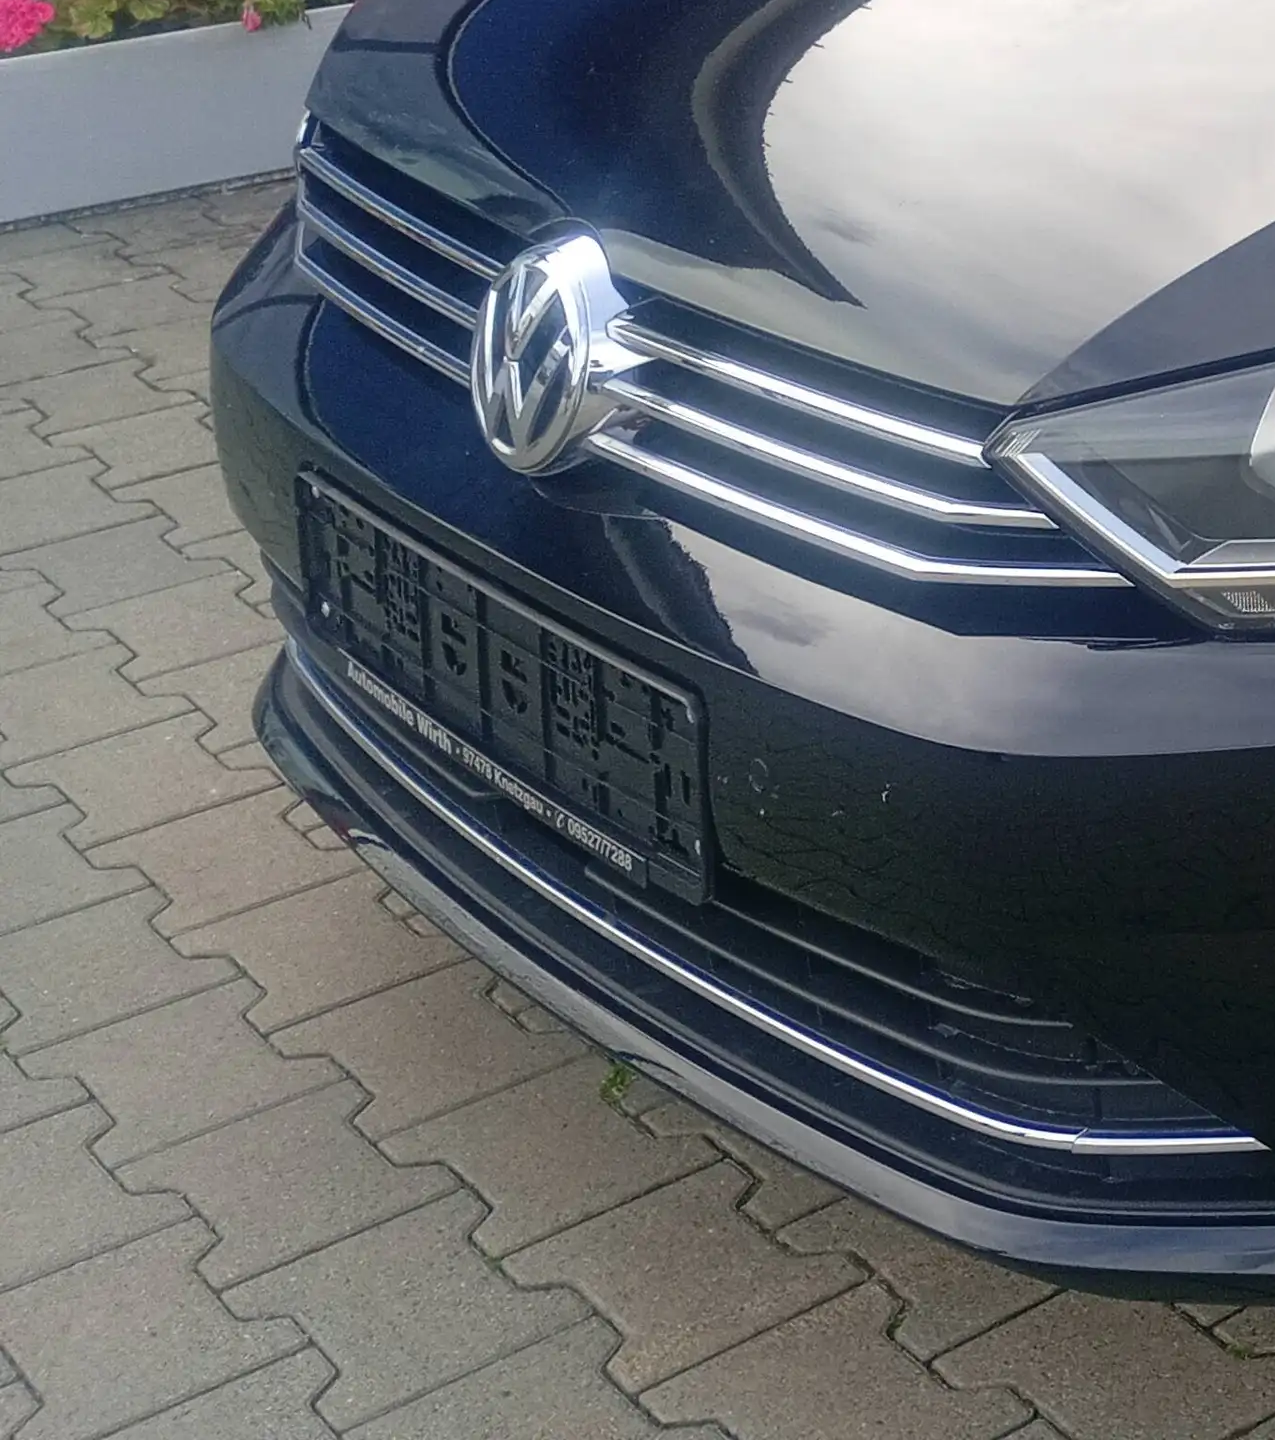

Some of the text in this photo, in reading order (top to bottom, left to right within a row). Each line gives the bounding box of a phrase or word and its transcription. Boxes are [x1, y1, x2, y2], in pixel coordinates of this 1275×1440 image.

[347, 660, 415, 727] Automobile
[416, 712, 452, 755] Wirth
[462, 747, 493, 780] 97478
[494, 767, 544, 813] Knetzgau
